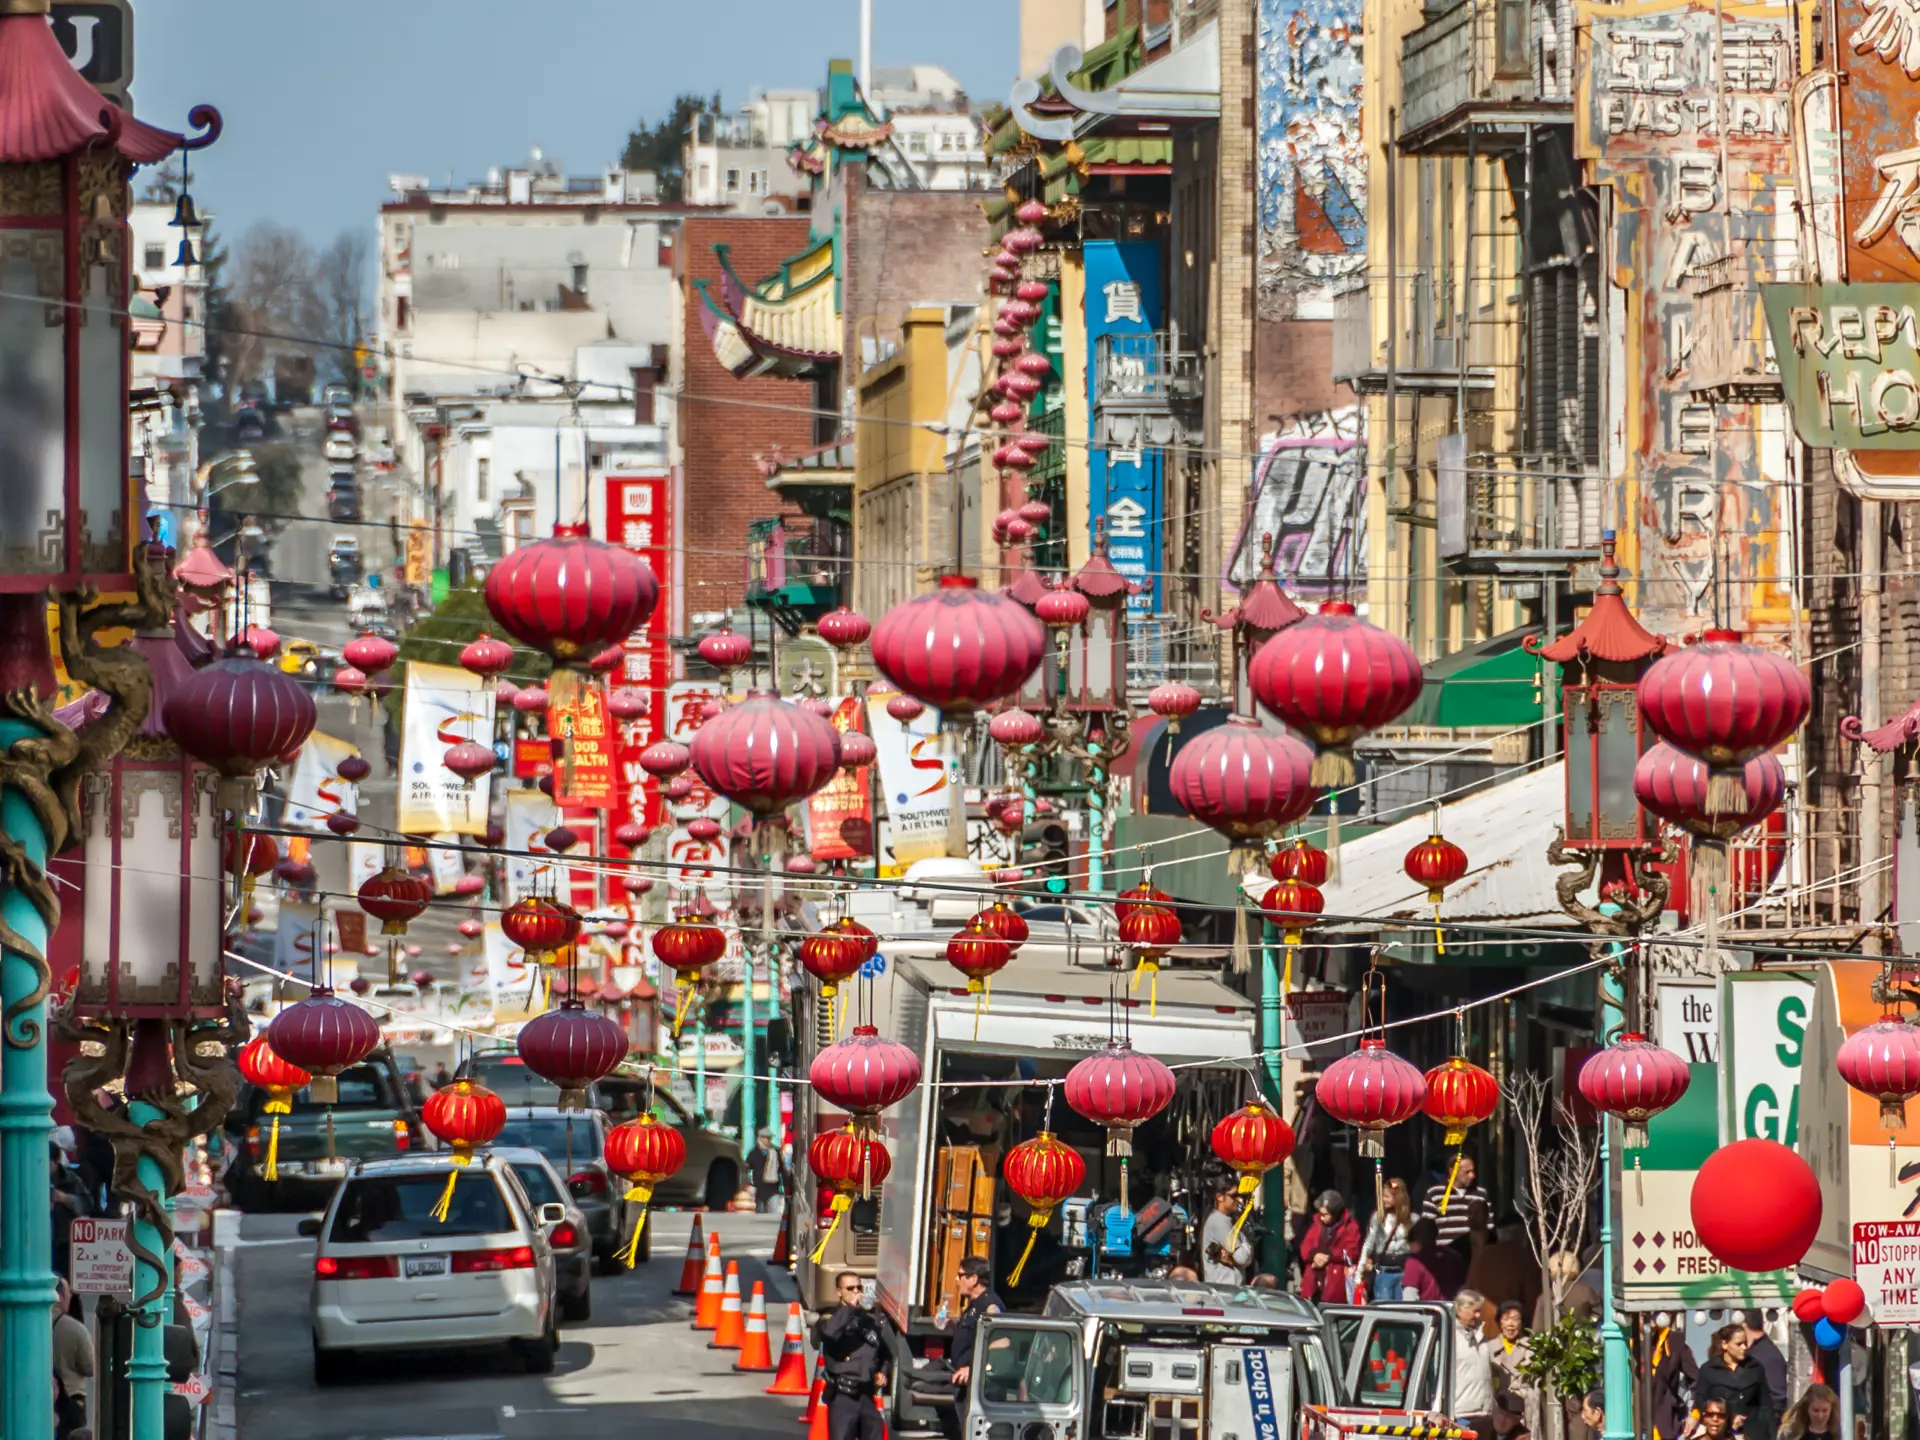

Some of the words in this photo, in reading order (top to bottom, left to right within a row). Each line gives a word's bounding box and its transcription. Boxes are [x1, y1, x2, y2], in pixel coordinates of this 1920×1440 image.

[1109, 545, 1144, 559] CHINA
[792, 658, 827, 696] 大
[1682, 994, 1713, 1023] the
[1305, 1020, 1327, 1031] ANY
[74, 1222, 94, 1241] NO
[97, 1227, 126, 1241] PARK
[1855, 1239, 1879, 1264] NO
[1677, 1256, 1729, 1275] FRESH
[1883, 1267, 1916, 1285] ANY
[1880, 1288, 1919, 1306] TIME
[1247, 1350, 1269, 1400] shoot
